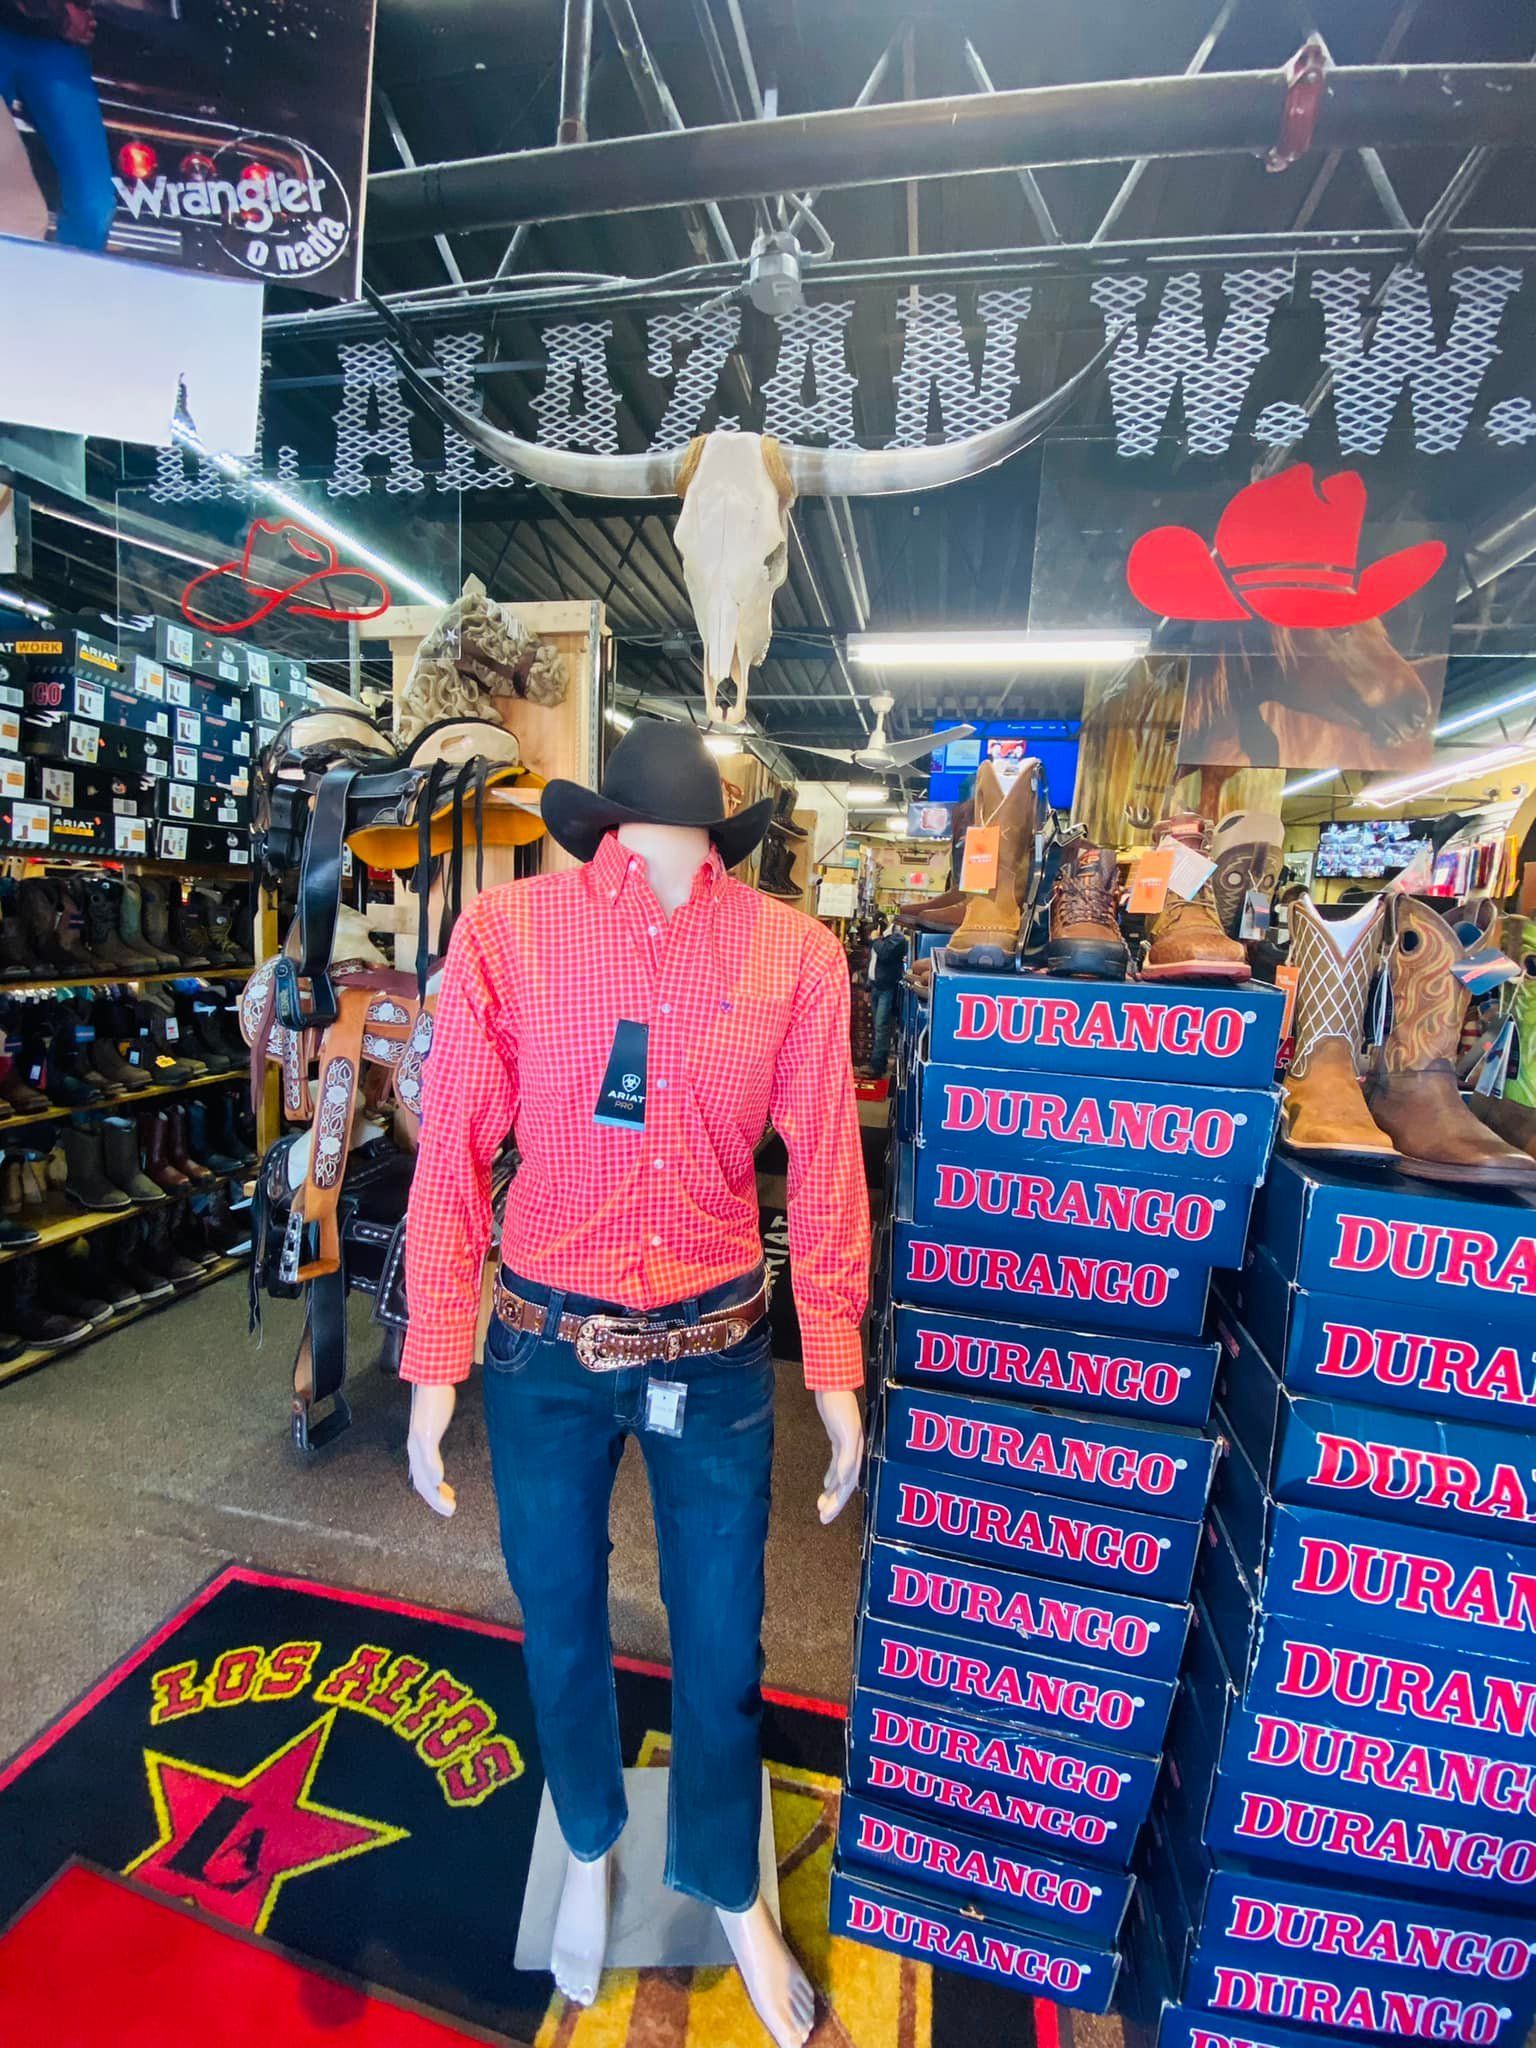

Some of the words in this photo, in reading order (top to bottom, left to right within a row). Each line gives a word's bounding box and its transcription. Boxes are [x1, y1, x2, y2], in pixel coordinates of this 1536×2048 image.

[111, 172, 327, 233] Wrangler
[246, 240, 270, 267] o
[275, 216, 347, 271] nada
[18, 642, 60, 653] WORK
[80, 643, 119, 664] ARIAT
[53, 817, 95, 830] ARIAT
[954, 993, 1246, 1058] DURANGO
[607, 1089, 646, 1104] ARIAT
[615, 1100, 634, 1111] PRO
[942, 1084, 1235, 1159] DURANGO
[935, 1164, 1214, 1241] DURANGO
[907, 1240, 1169, 1308] DURANGO
[915, 1329, 1180, 1406] DURANGO
[906, 1408, 1176, 1495] DURANGO
[897, 1483, 1160, 1575] DURANGO
[888, 1565, 1149, 1657] DURANGO
[879, 1639, 1135, 1730] DURANGO
[151, 1641, 322, 1726] LOS
[313, 1643, 525, 1808] ALTOS
[870, 1709, 1121, 1801] DURANGO
[868, 1756, 1107, 1845] DURANGO
[858, 1813, 1092, 1914] DURANGO
[847, 1895, 1082, 1992] DURANGO
[1226, 1895, 1530, 1981] DURANGO
